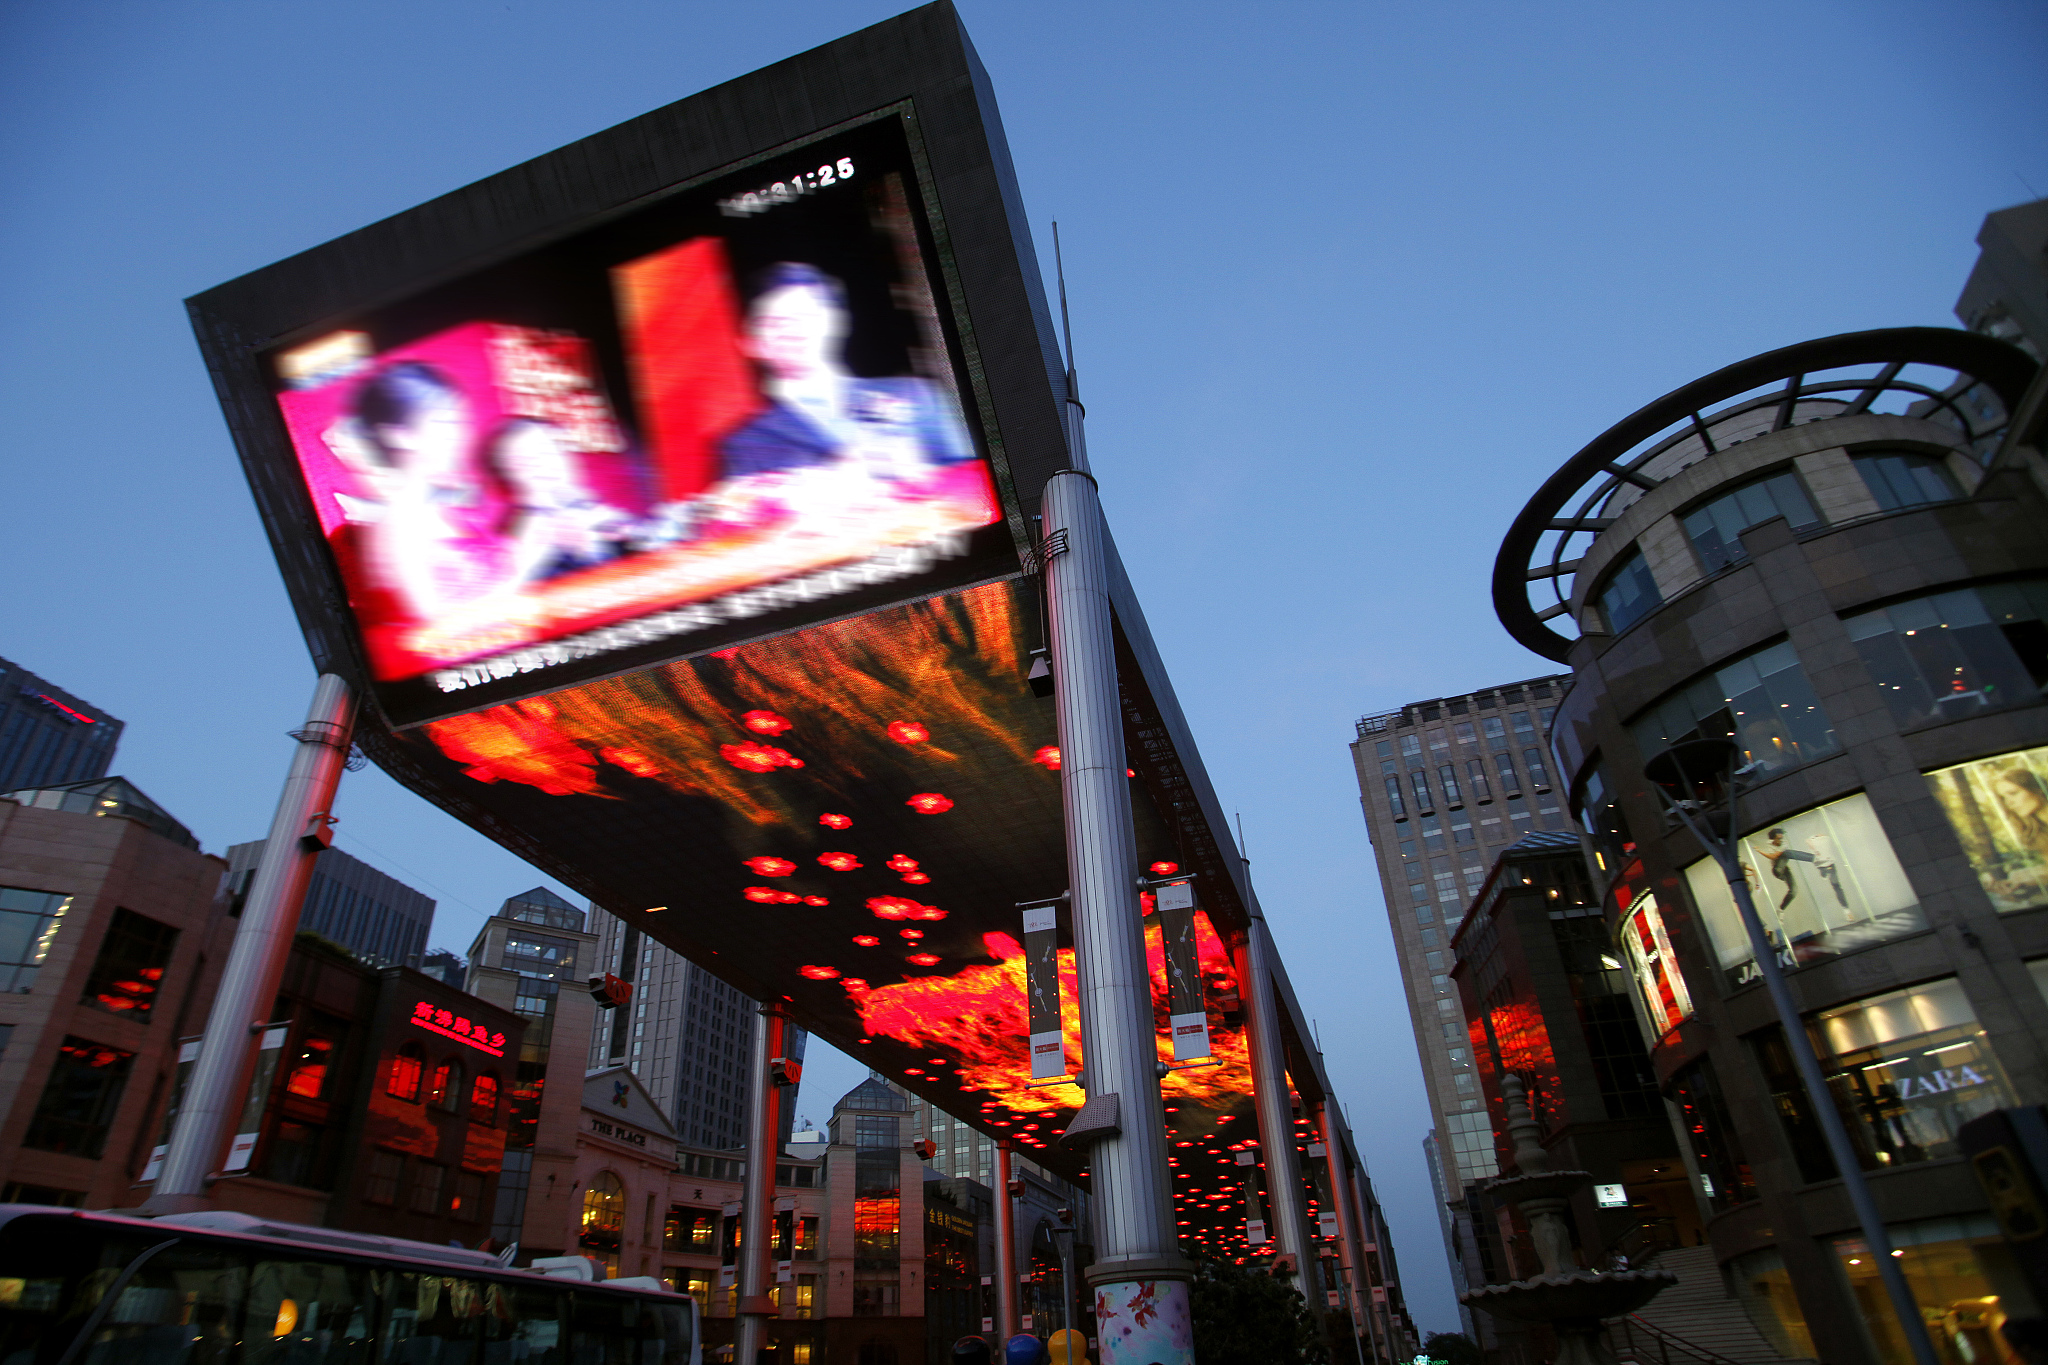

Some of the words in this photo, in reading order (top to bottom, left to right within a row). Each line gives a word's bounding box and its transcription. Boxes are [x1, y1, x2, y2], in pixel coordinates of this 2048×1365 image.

[1738, 948, 1794, 985] JAK
[1894, 1065, 1987, 1100] ZARA
[592, 1119, 613, 1136] THE
[615, 1127, 647, 1146] PLACE
